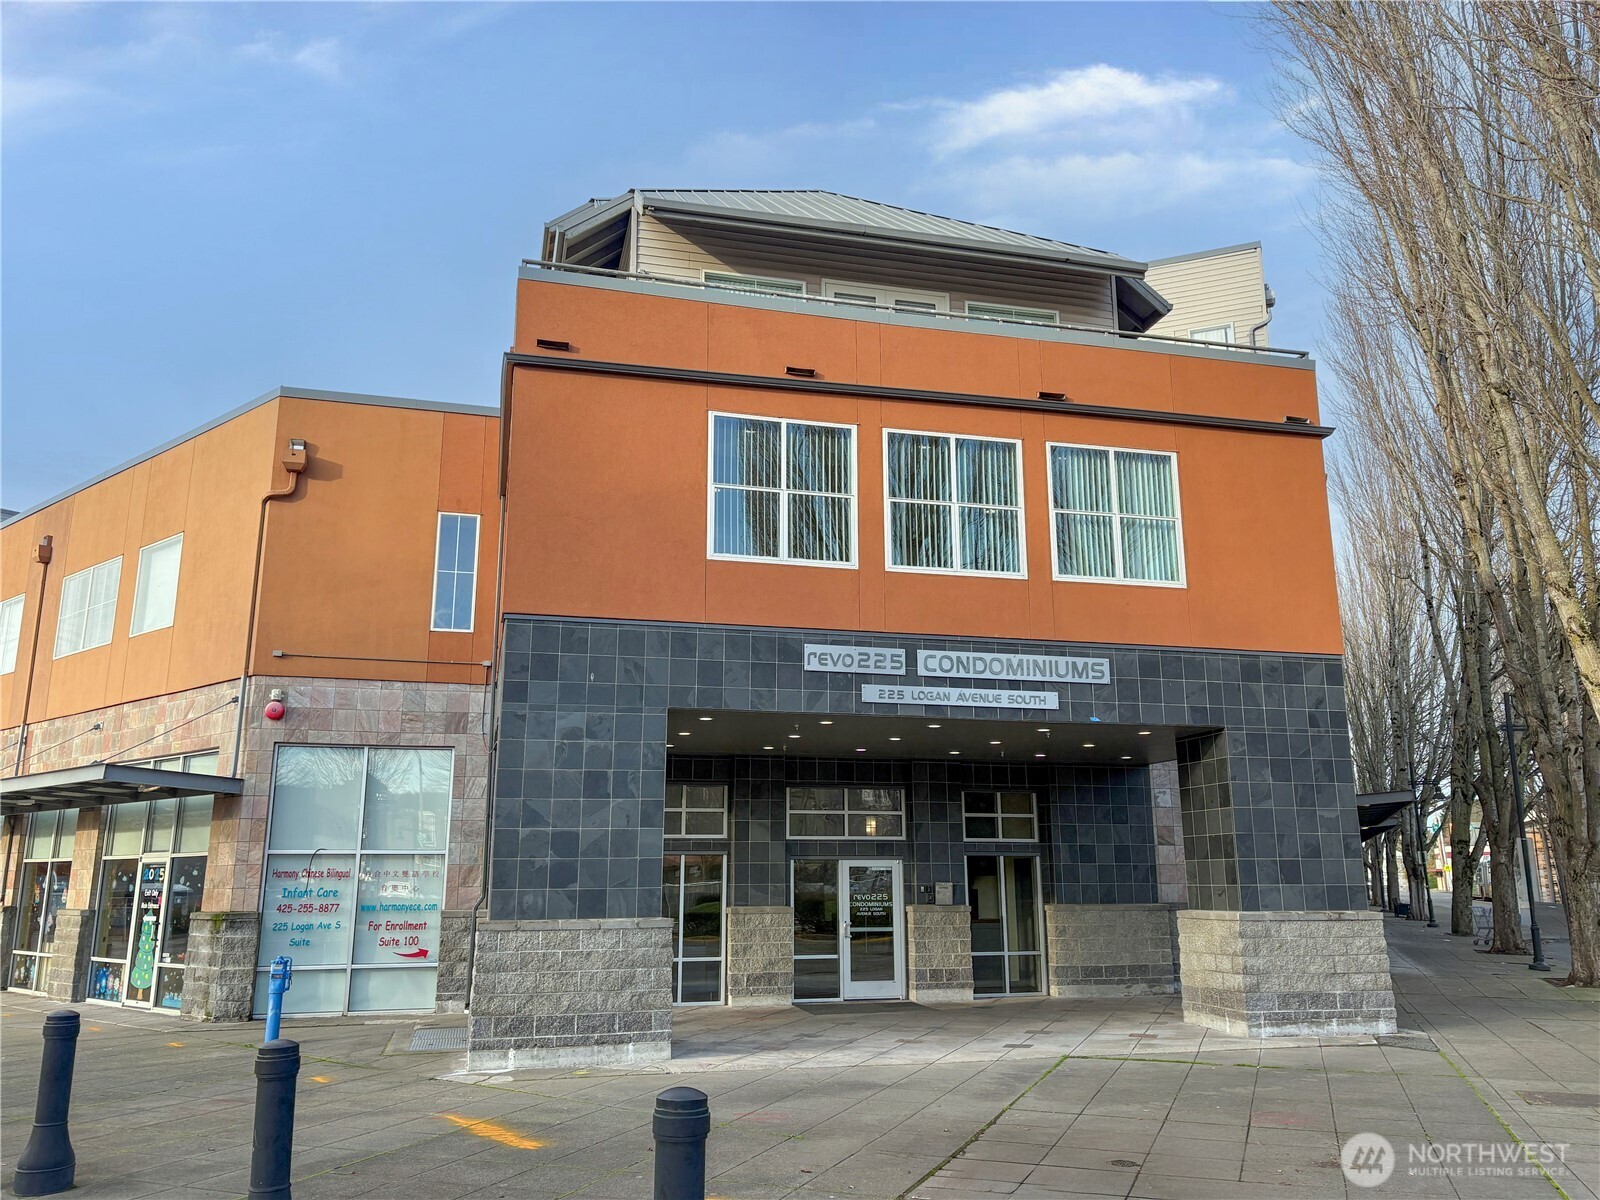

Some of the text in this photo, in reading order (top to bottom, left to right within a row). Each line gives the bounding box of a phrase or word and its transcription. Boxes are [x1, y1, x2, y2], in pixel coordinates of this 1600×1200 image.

[923, 653, 1106, 681] CONDOMINIUMS
[878, 688, 1047, 706] 225 LOGAN AVENUE SOUTH
[143, 868, 165, 880] 2025
[272, 868, 351, 880] Harmony Chinese Bilingual
[281, 887, 339, 899] Infant Care
[276, 903, 341, 914] 425-255-8877
[361, 902, 437, 913] www.harmonyece.com
[272, 920, 341, 933] 225 Logan Ave S
[368, 919, 427, 931] For Enrollment
[289, 938, 311, 947] Suite
[378, 936, 419, 947] Suite 100
